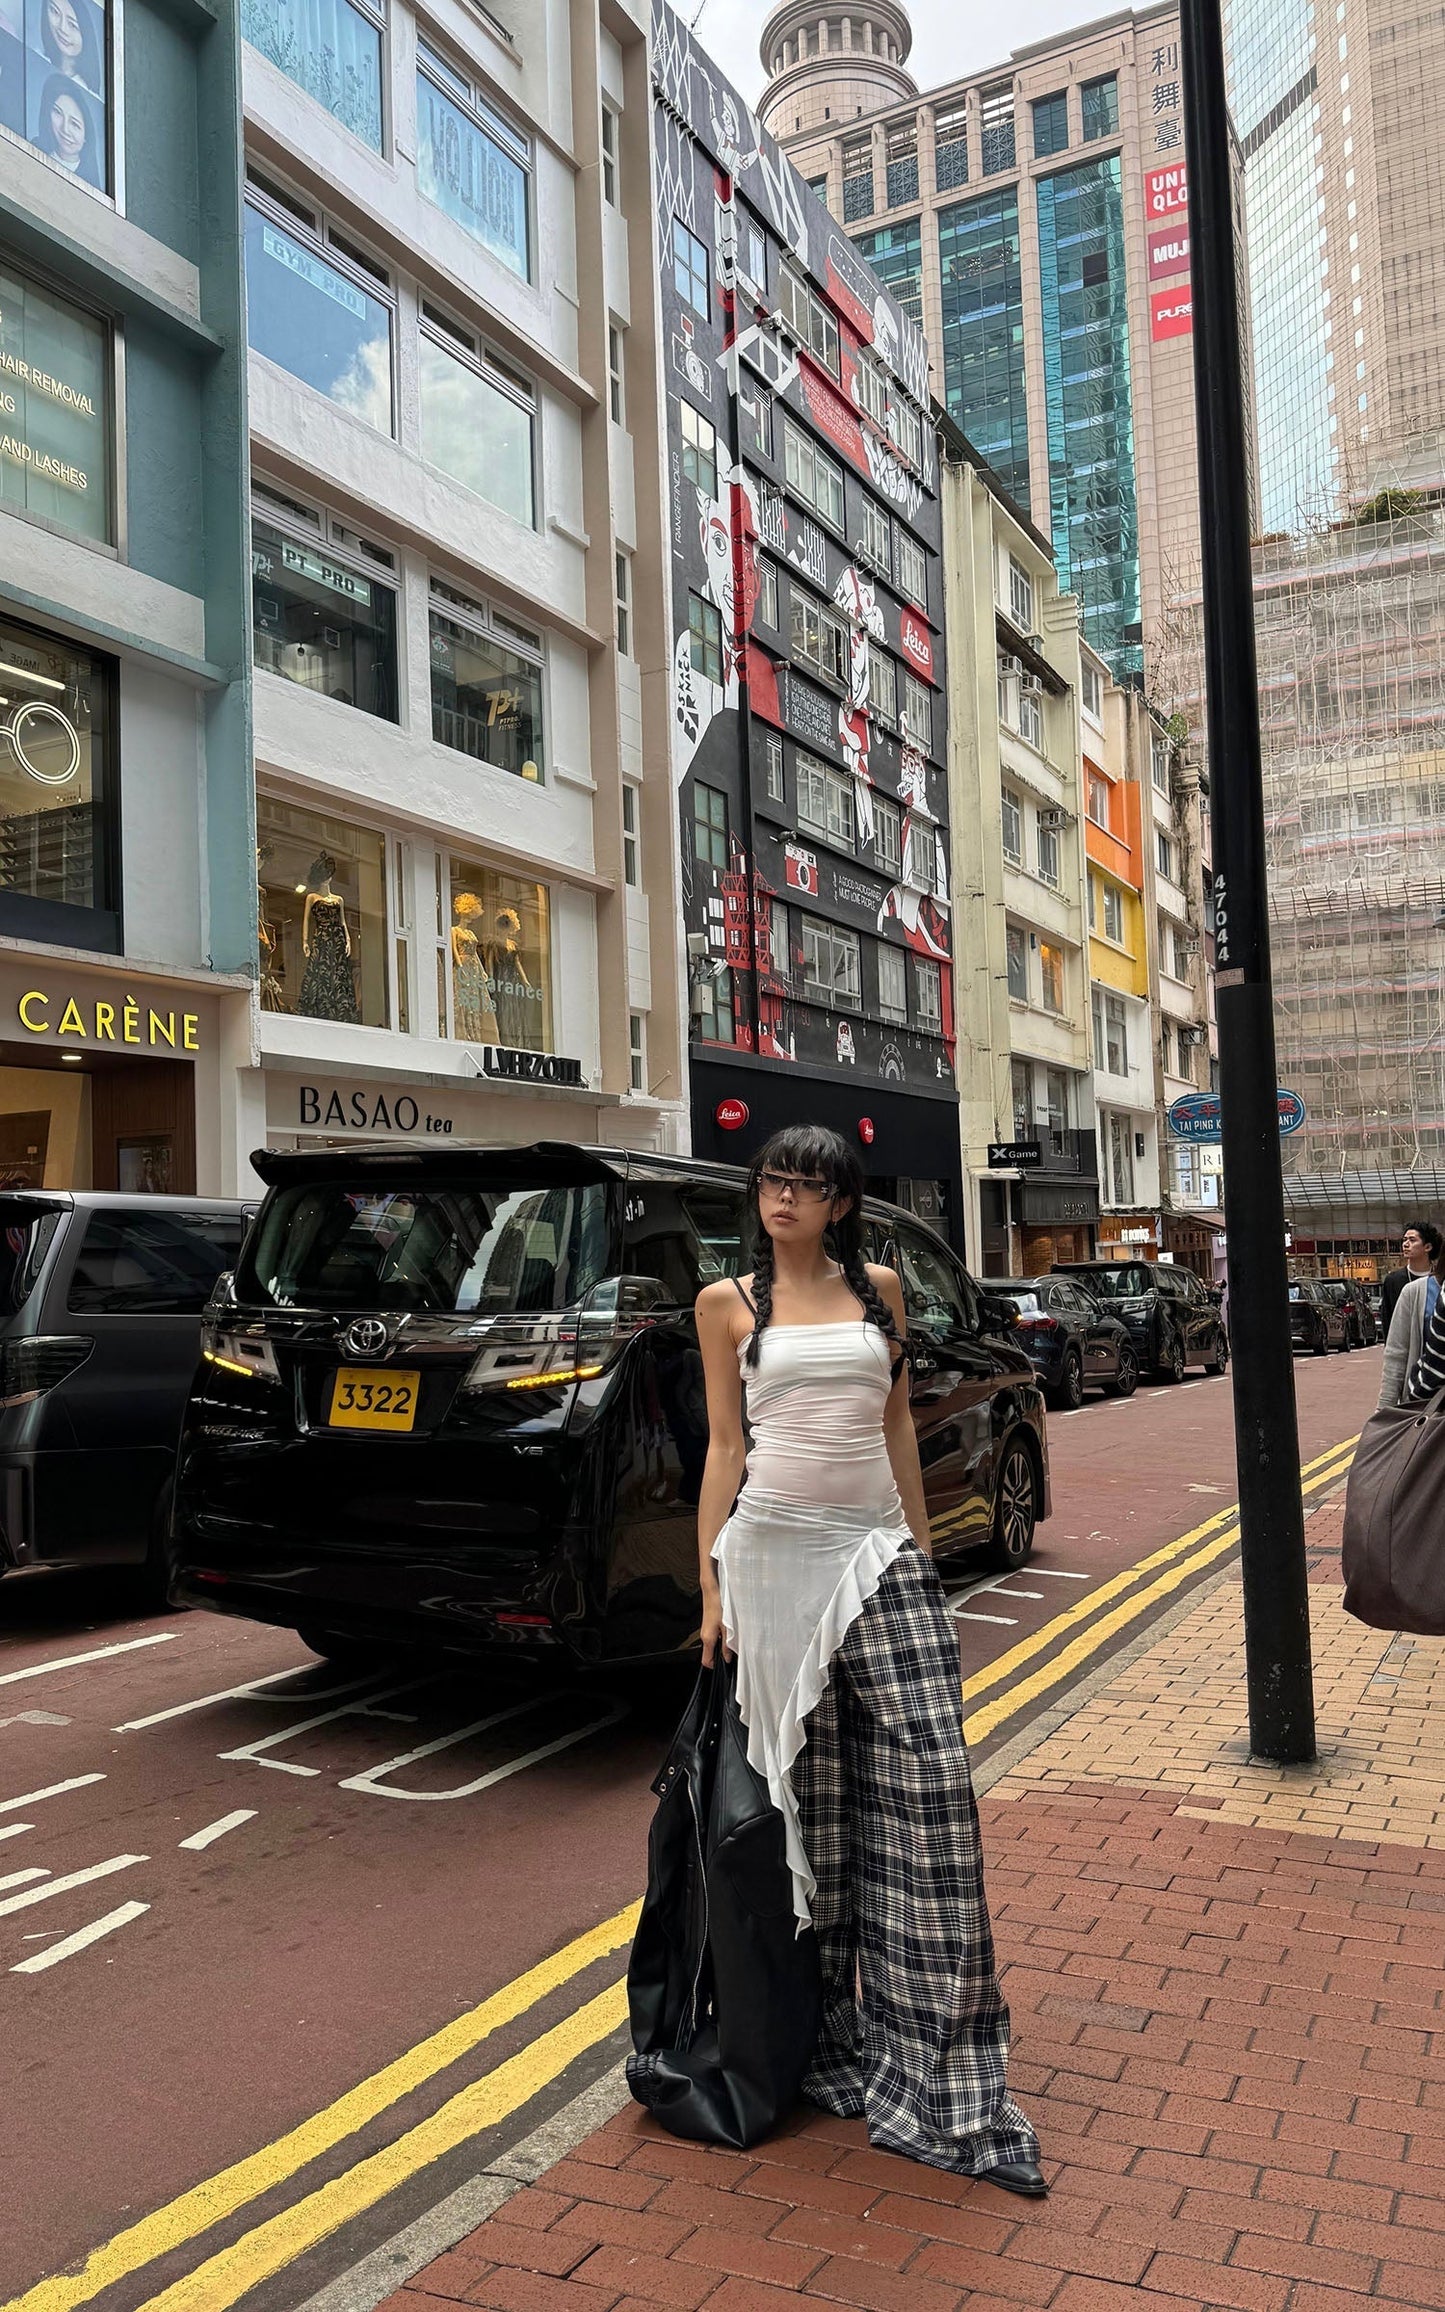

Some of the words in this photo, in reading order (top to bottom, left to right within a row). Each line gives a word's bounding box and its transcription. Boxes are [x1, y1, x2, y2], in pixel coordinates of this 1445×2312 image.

[1151, 42, 1182, 153] 利舞臺
[1152, 168, 1186, 192] UNI
[1153, 186, 1188, 212] QLO
[1153, 239, 1190, 264] MUJ
[273, 239, 312, 278] GYM
[323, 274, 357, 309] PRO
[32, 368, 96, 416] REMOVAL
[1, 435, 32, 461] AND
[34, 450, 88, 490] LASHES
[286, 548, 307, 571] PT
[321, 566, 355, 594] PRO
[903, 619, 930, 665] Leica
[1214, 873, 1230, 961] 47044
[458, 966, 545, 1001] Clearance
[458, 988, 497, 1013] Sale
[18, 991, 200, 1051] CARÈNE
[300, 1086, 419, 1131] BASAO
[425, 1114, 453, 1134] tea
[718, 1107, 741, 1120] Leica
[1178, 1121, 1192, 1132] TAI
[1194, 1119, 1214, 1131] PING
[1278, 1114, 1295, 1126] ANT
[991, 1147, 1008, 1160] X
[1008, 1150, 1038, 1159] Game
[338, 1384, 412, 1414] 3322
[513, 1445, 544, 1456] V6
